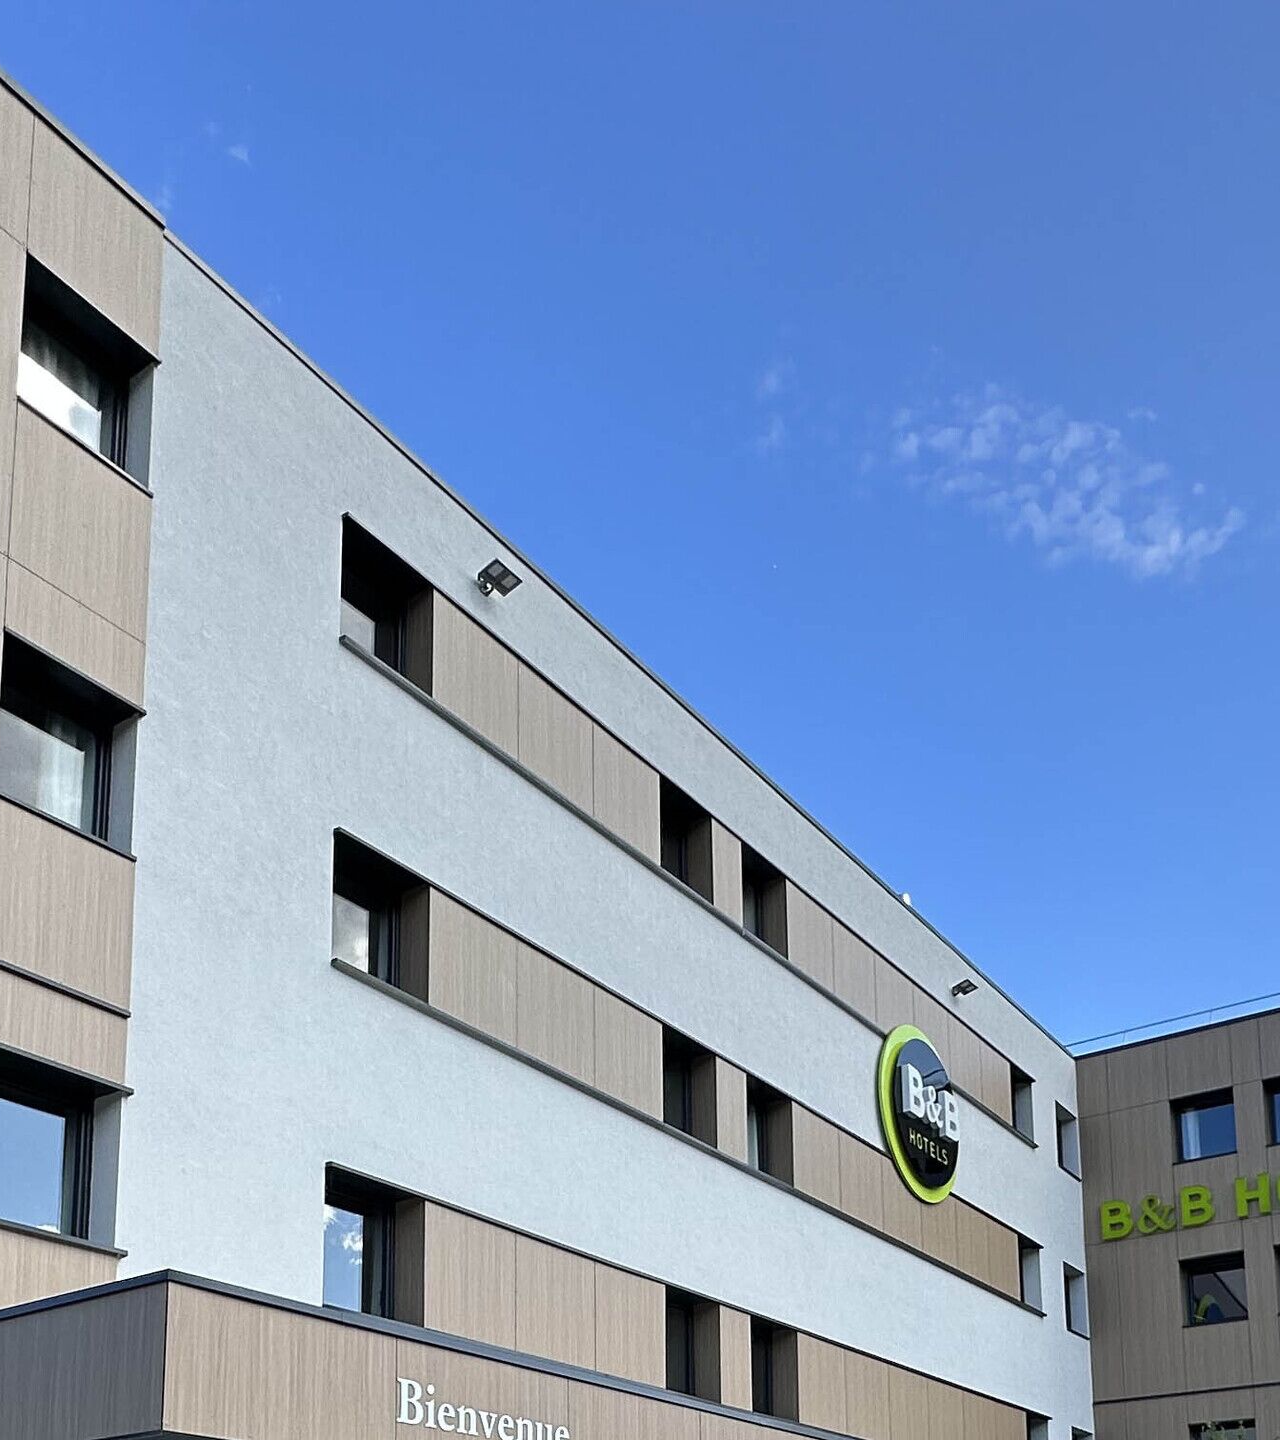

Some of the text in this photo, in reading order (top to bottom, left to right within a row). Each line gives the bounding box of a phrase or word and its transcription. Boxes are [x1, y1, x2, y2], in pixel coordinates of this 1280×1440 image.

[899, 1063, 960, 1142] B&B
[909, 1127, 949, 1166] HOTELS
[1099, 1185, 1217, 1241] B&B
